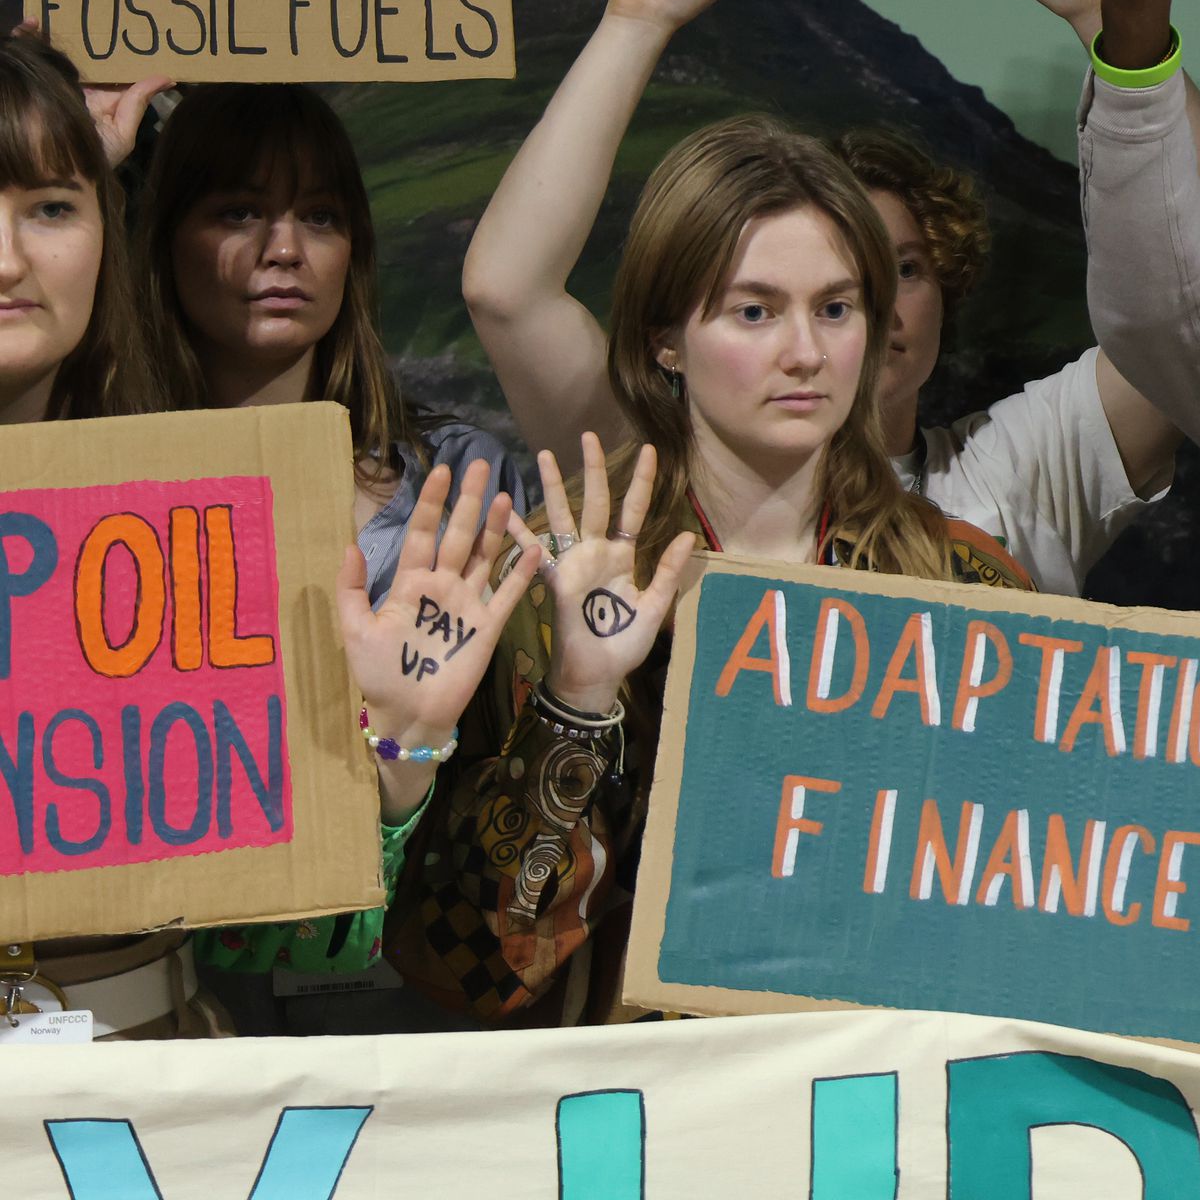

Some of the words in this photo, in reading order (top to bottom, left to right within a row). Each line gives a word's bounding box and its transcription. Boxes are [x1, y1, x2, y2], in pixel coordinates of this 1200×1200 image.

[73, 504, 275, 678] OIL
[415, 594, 476, 662] PAY
[401, 641, 440, 682] UP
[31, 1027, 61, 1035] Norway
[49, 1014, 88, 1025] UNFCCC
